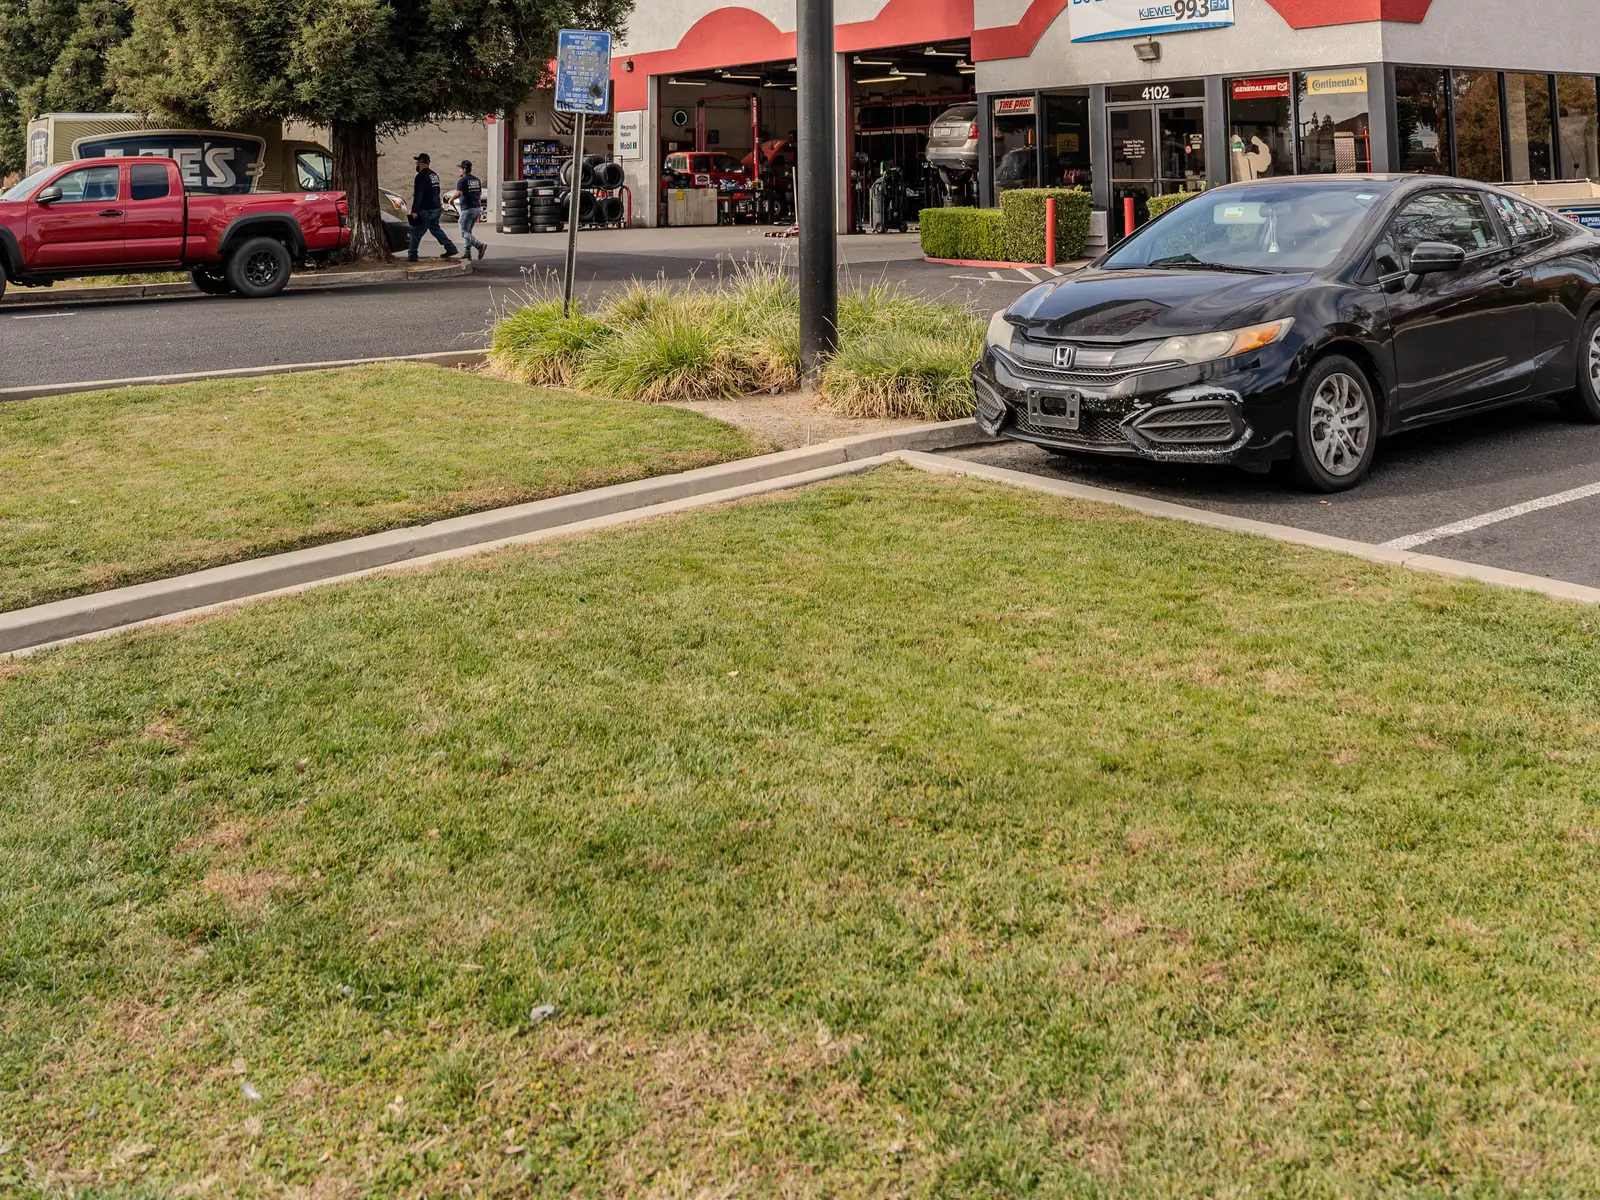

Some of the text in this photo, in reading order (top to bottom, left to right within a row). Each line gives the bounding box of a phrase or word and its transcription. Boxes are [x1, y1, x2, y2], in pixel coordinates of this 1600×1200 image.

[1234, 84, 1263, 93] GENERAL
[1312, 77, 1357, 91] Continental
[1142, 85, 1170, 100] 4102
[998, 99, 1032, 114] TIRE PROS
[104, 142, 236, 188] E'S
